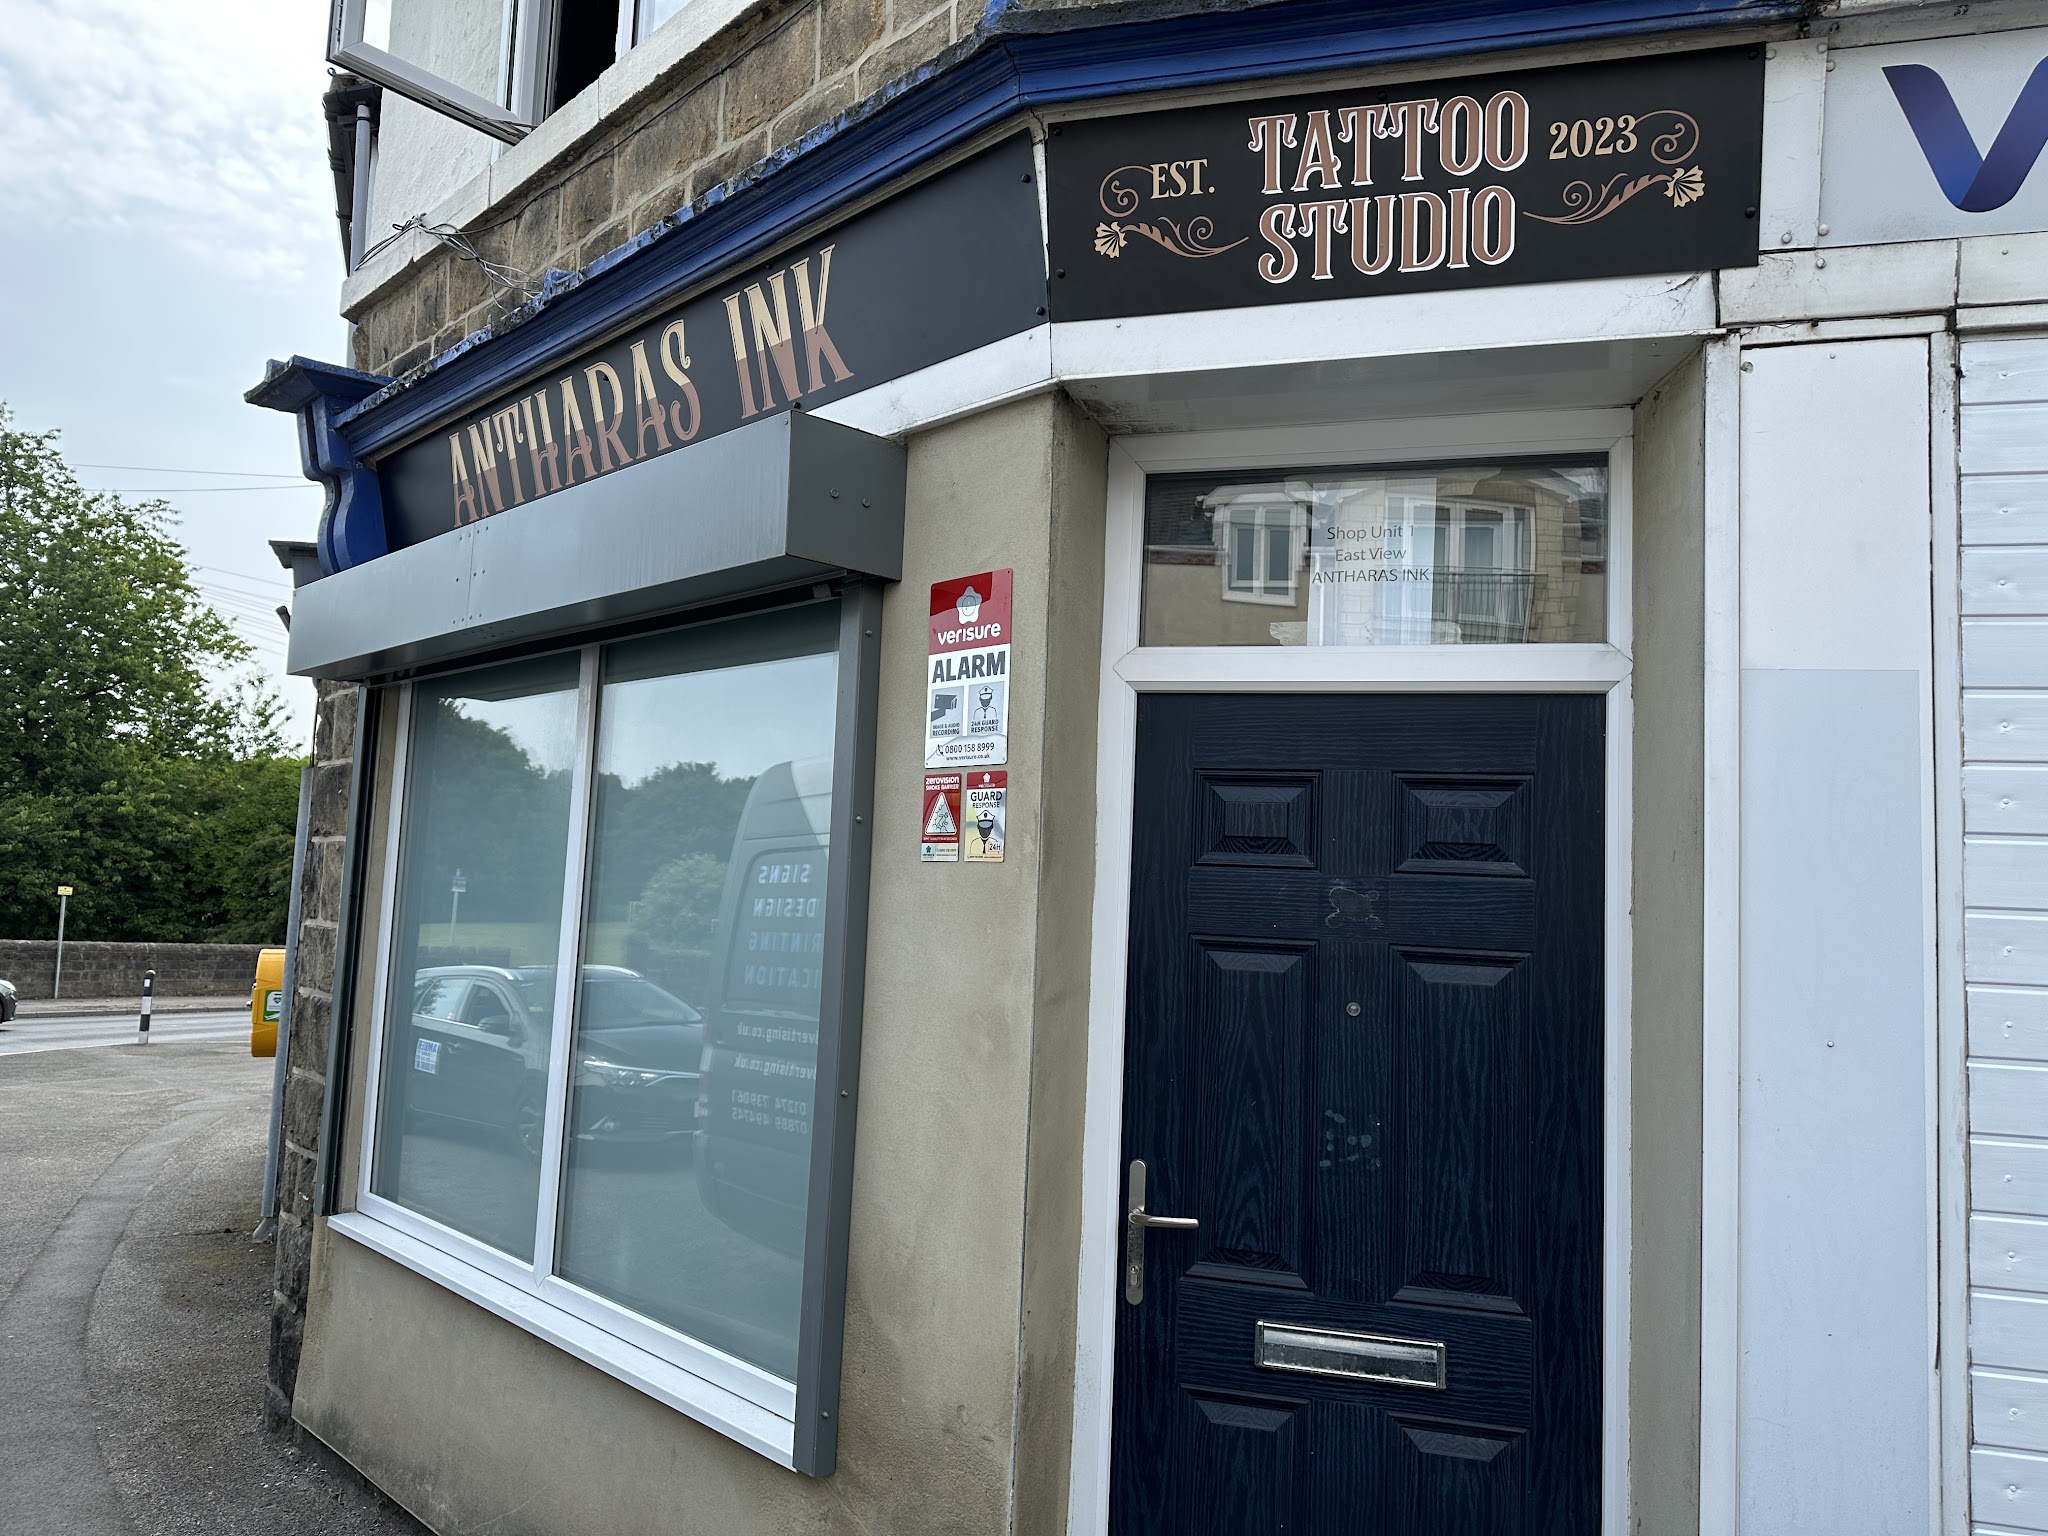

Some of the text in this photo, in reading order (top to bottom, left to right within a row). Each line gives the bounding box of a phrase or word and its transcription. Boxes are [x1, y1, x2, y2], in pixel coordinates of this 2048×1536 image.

[1247, 90, 1530, 195] TATTOO
[1548, 114, 1639, 160] 2023
[1150, 158, 1215, 199] EST.
[1258, 185, 1517, 284] STUDIO
[448, 243, 855, 529] ANTHARAS INK
[1326, 525, 1367, 541] Shop
[1371, 524, 1403, 539] Unit
[1335, 546, 1407, 562] East View
[1311, 567, 1430, 584] ANTHARAS INK
[938, 622, 1001, 646] verisure
[932, 650, 1006, 683] ALARM
[932, 728, 960, 736] RECORDING
[970, 725, 999, 733] RESPONSE
[945, 742, 995, 754] 0800 158 8999
[946, 753, 991, 761] www.verisure.co.uk
[925, 776, 960, 785] zerovision
[970, 791, 1003, 802] GUARD
[972, 801, 1000, 809] RESPONSE
[989, 843, 1001, 851] 24H
